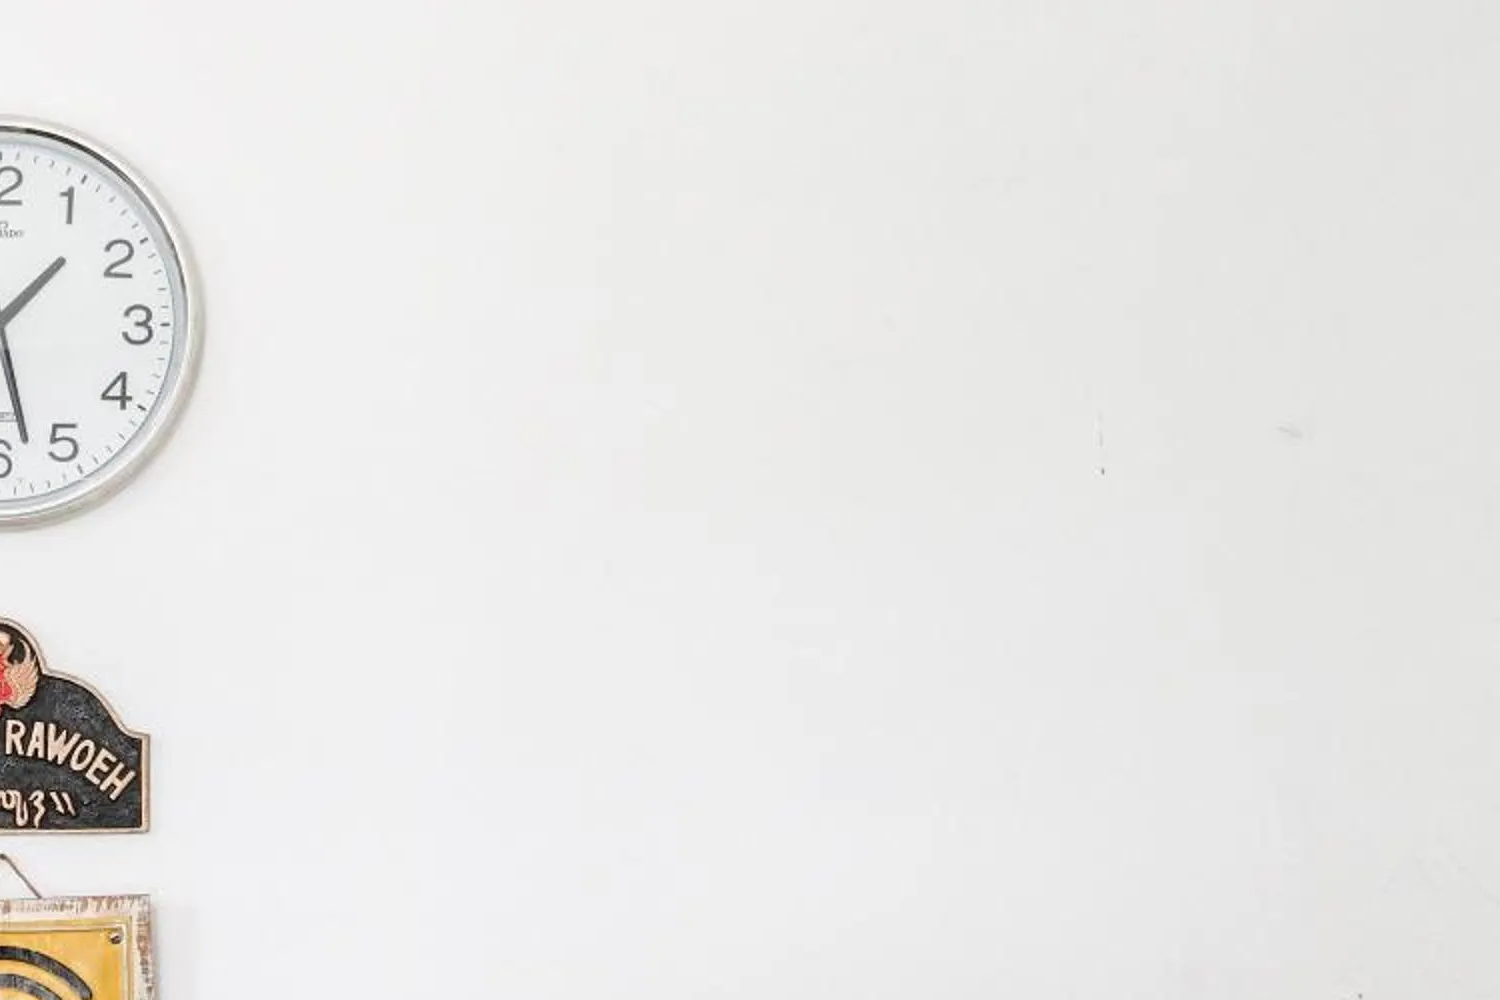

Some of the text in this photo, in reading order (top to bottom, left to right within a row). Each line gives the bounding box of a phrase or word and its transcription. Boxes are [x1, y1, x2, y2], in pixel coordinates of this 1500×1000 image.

[59, 186, 75, 225] 1
[103, 239, 135, 279] 2
[121, 303, 154, 346] 3
[100, 371, 133, 411] 4
[47, 423, 80, 463] 5
[5, 719, 136, 800] RAWOEH
